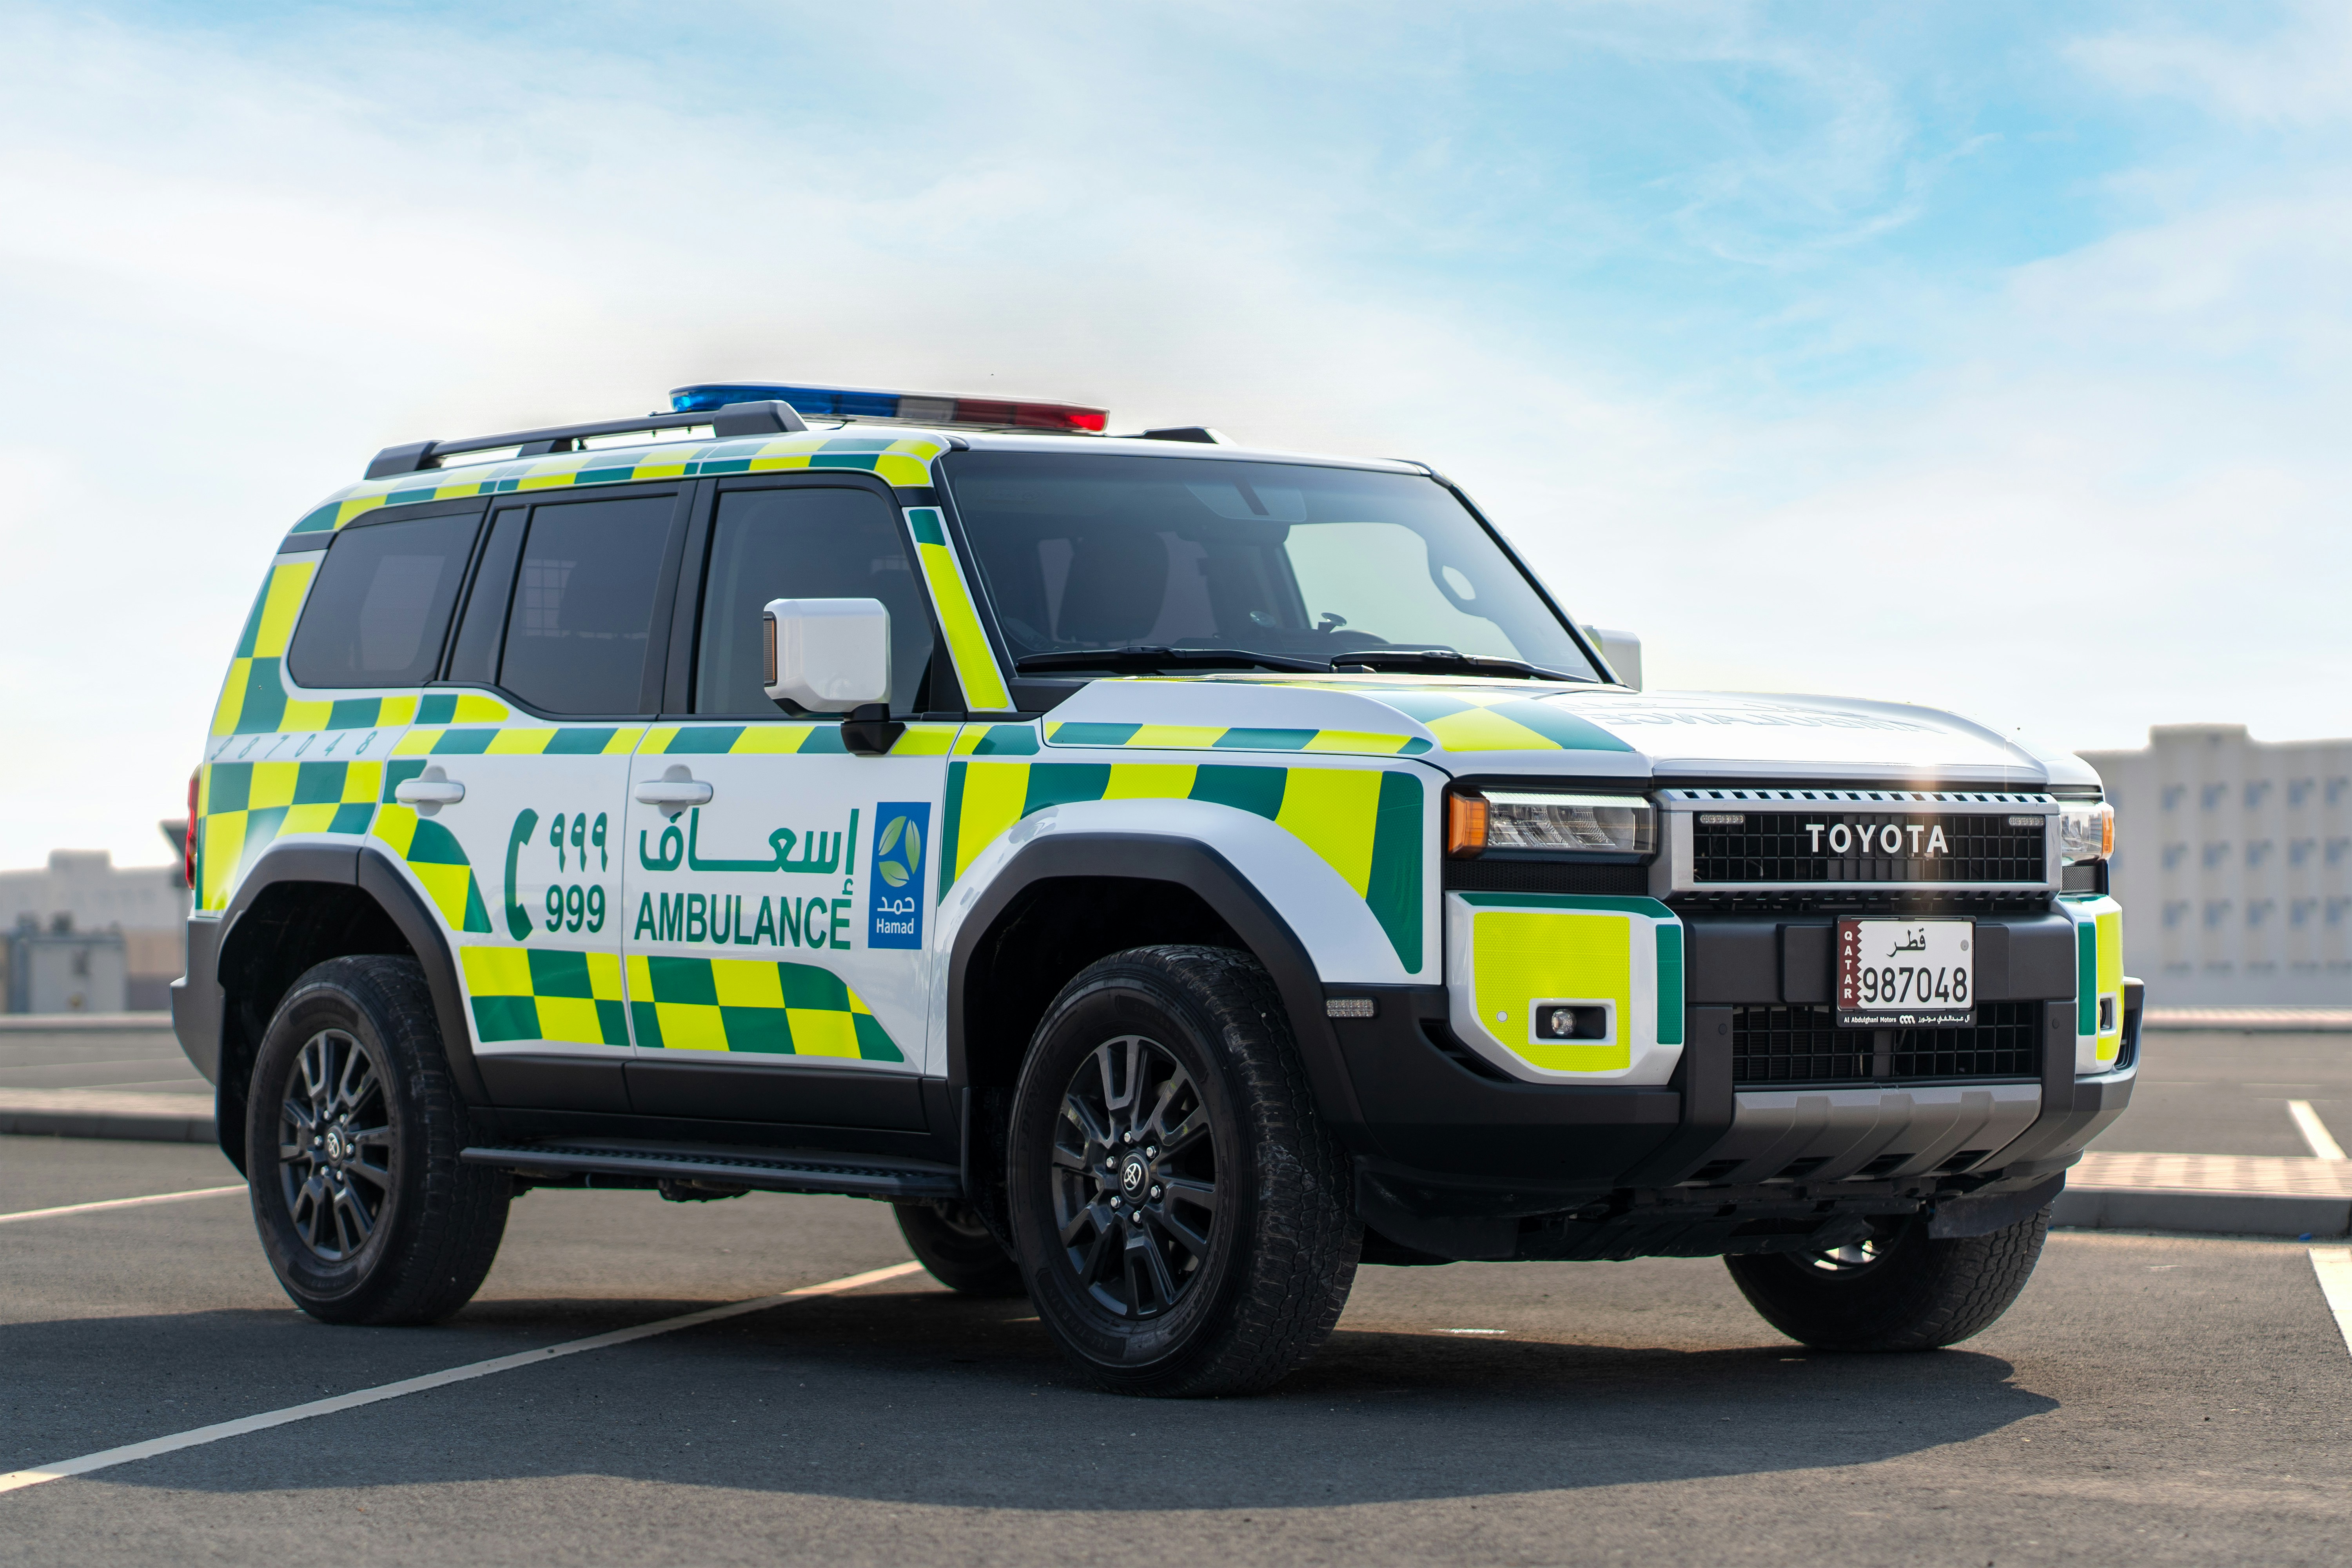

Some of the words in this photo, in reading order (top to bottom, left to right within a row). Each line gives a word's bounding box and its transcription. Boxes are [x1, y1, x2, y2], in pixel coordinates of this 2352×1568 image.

[211, 730, 378, 761] 987048
[550, 812, 608, 873] ٩٩٩
[639, 807, 860, 896] إسعاف
[1806, 824, 1948, 853] TOYOTA
[545, 884, 606, 934] 999
[634, 892, 852, 951] AMBULANCE
[876, 918, 914, 934] Hamad
[877, 896, 915, 915] حمد
[1886, 927, 1926, 957] قطر
[1844, 931, 1853, 999] QATAR
[1862, 967, 1967, 1003] 987048
[1851, 1016, 1878, 1024] Abdulghani
[1022, 1043, 1056, 1139] DUNLOP
[1045, 1288, 1110, 1350] ALL-TERRAIN
